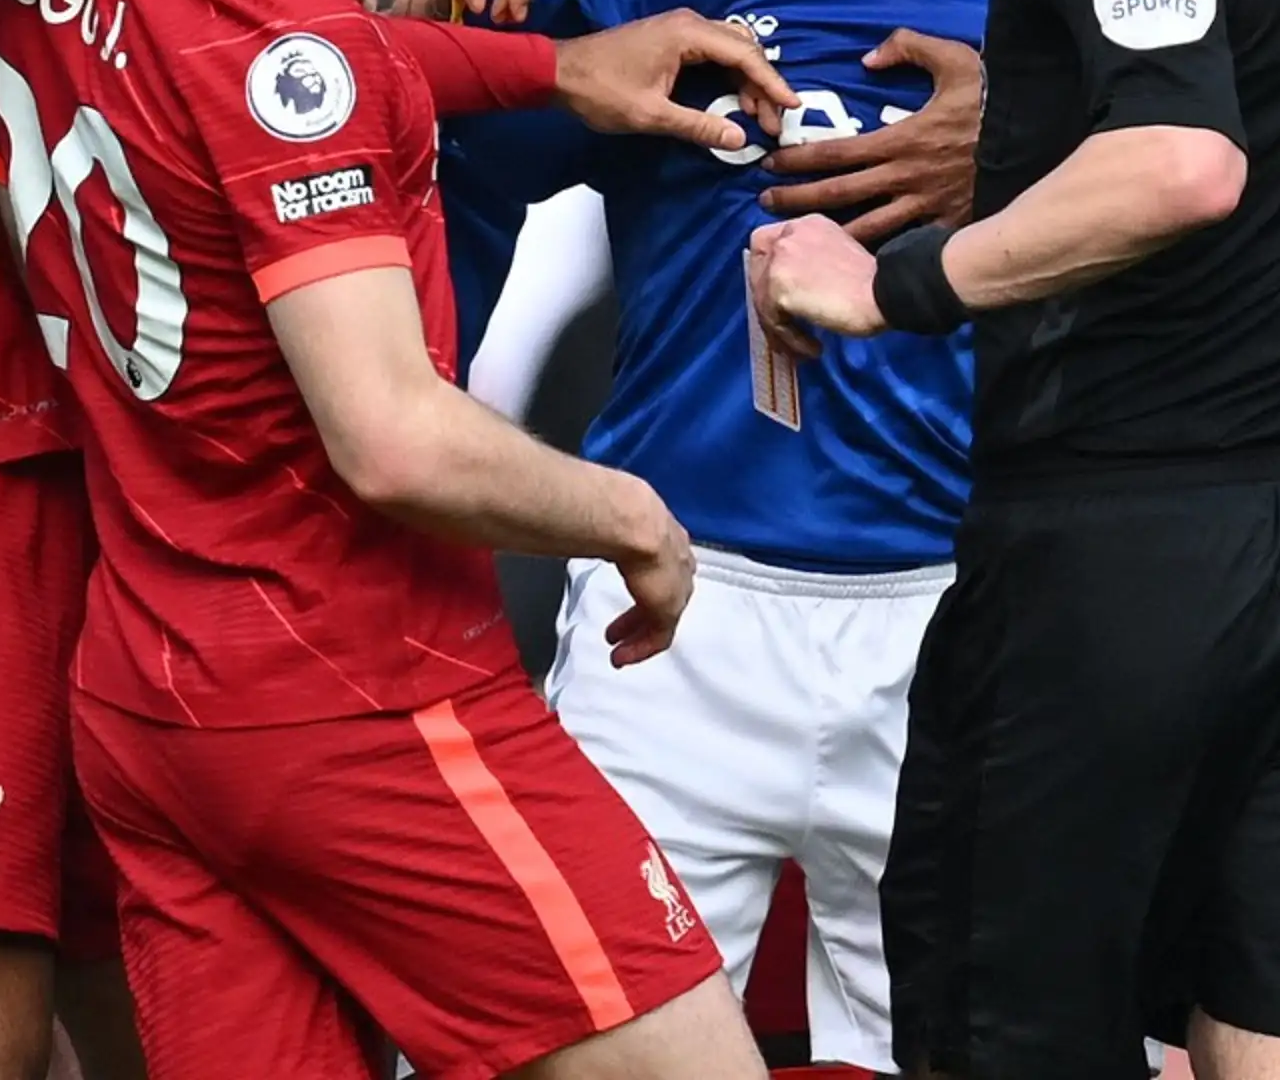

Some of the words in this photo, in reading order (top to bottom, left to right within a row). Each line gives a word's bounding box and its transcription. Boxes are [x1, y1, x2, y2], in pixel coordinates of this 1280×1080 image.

[270, 181, 308, 202] No
[308, 168, 365, 196] room
[276, 199, 310, 223] for
[311, 186, 376, 215] racism
